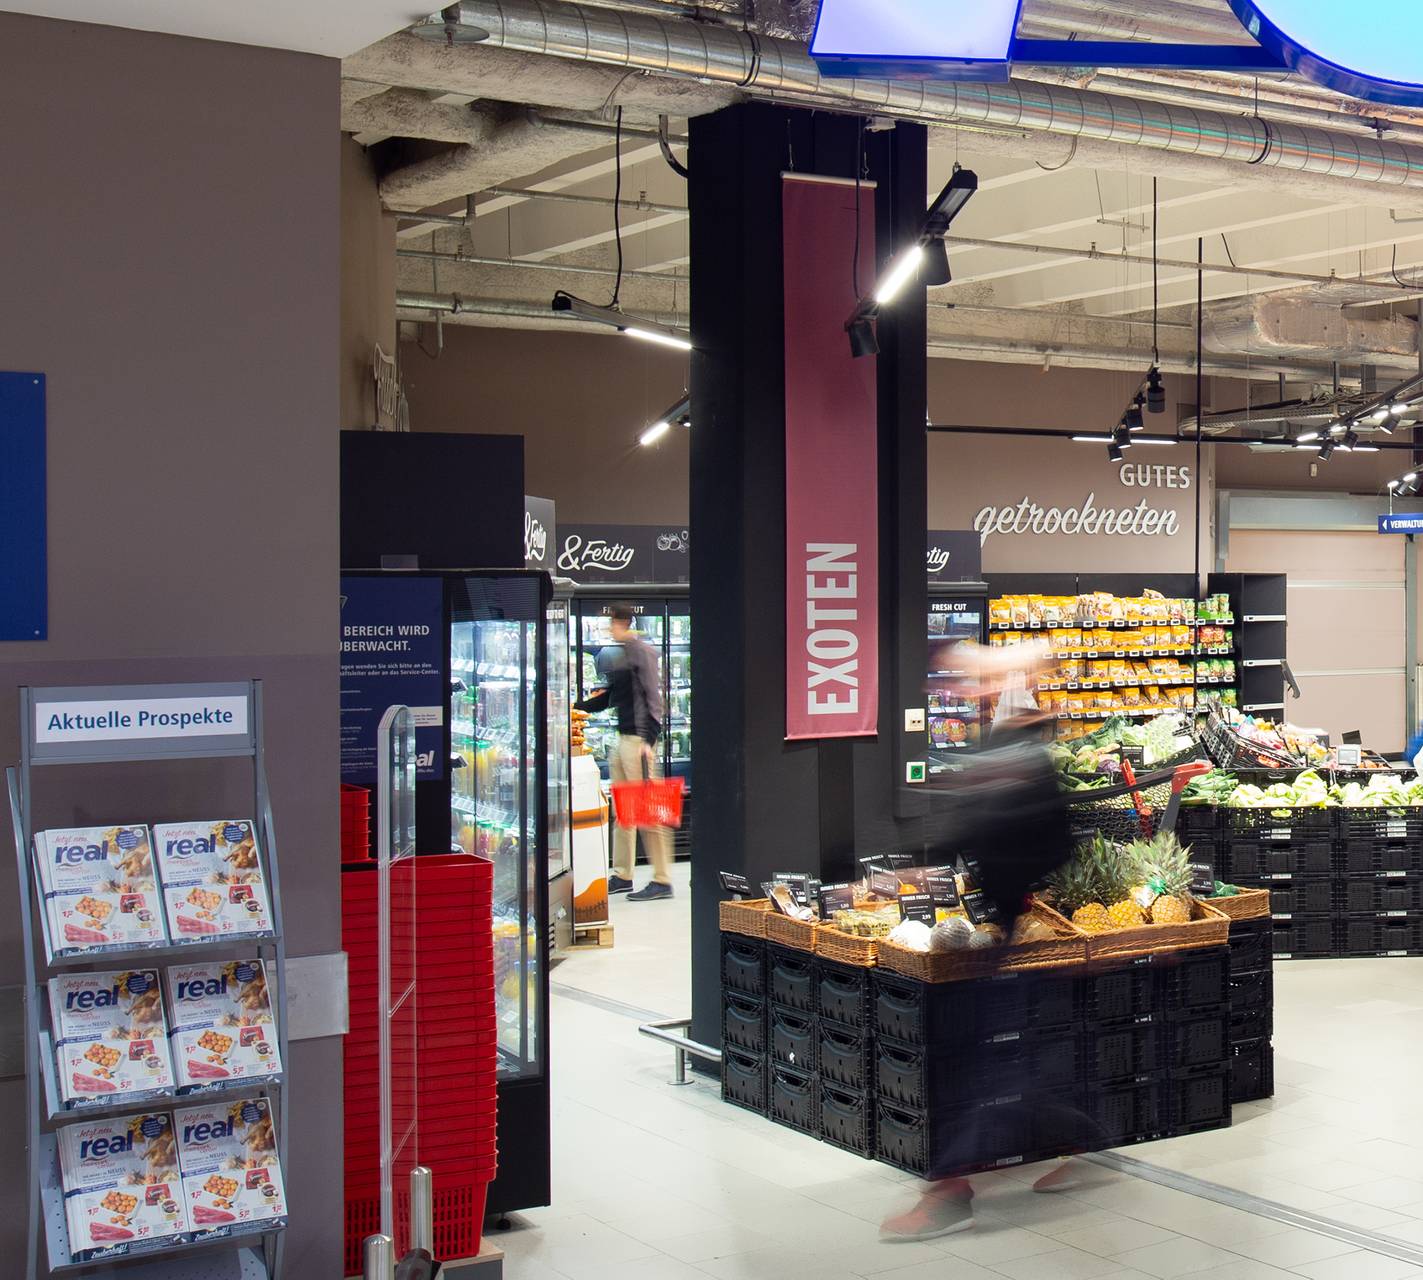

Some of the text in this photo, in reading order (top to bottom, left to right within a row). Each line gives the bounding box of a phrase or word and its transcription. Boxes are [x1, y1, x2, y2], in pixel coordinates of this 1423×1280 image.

[1119, 463, 1191, 489] GUTES
[973, 492, 1180, 548] getrockneten
[926, 546, 950, 572] tig
[344, 625, 430, 636] BEREICH WIRD
[806, 543, 859, 715] EXOTEN
[47, 707, 234, 730] Aktuelle Prospekte
[414, 750, 435, 767] al
[55, 840, 109, 864] real
[166, 834, 216, 857] real
[66, 984, 120, 1010] real
[178, 974, 228, 999] real
[184, 1114, 235, 1144] real
[80, 1129, 134, 1159] real
